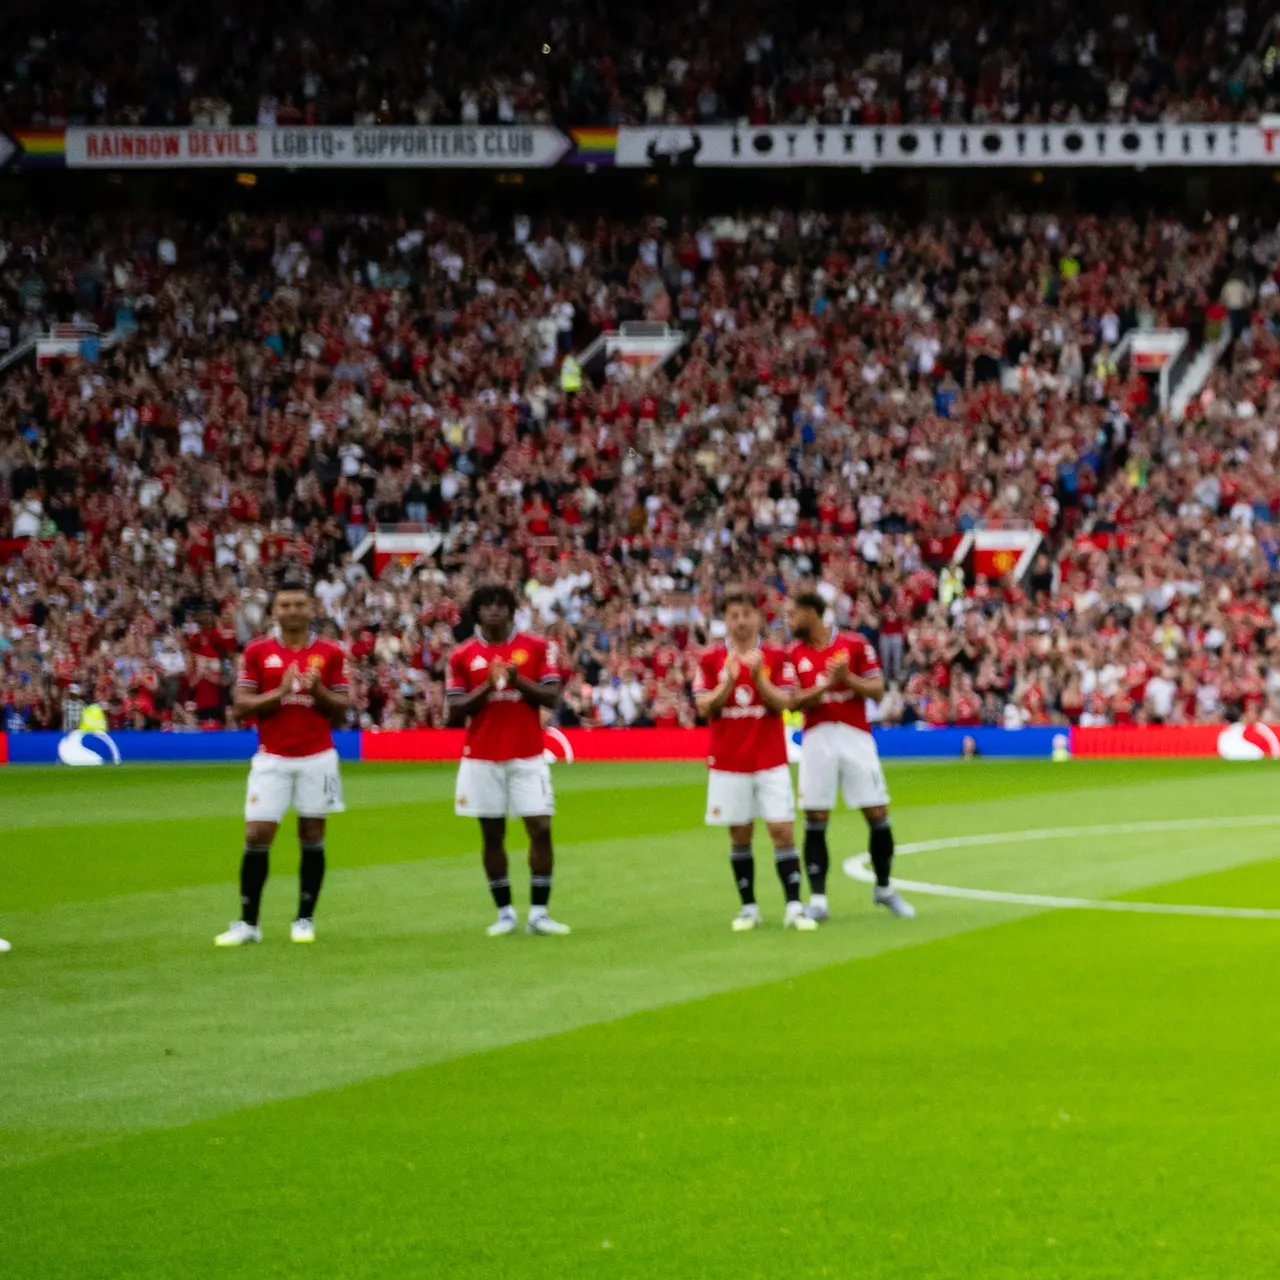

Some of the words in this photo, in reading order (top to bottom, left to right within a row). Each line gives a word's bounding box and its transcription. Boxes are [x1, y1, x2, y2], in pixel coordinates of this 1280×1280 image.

[86, 132, 180, 158] RAINBOW
[188, 131, 258, 157] DEVILS
[272, 131, 345, 157] LGBTQ+
[353, 130, 477, 157] SUPPORTERS
[484, 130, 534, 157] CLUB
